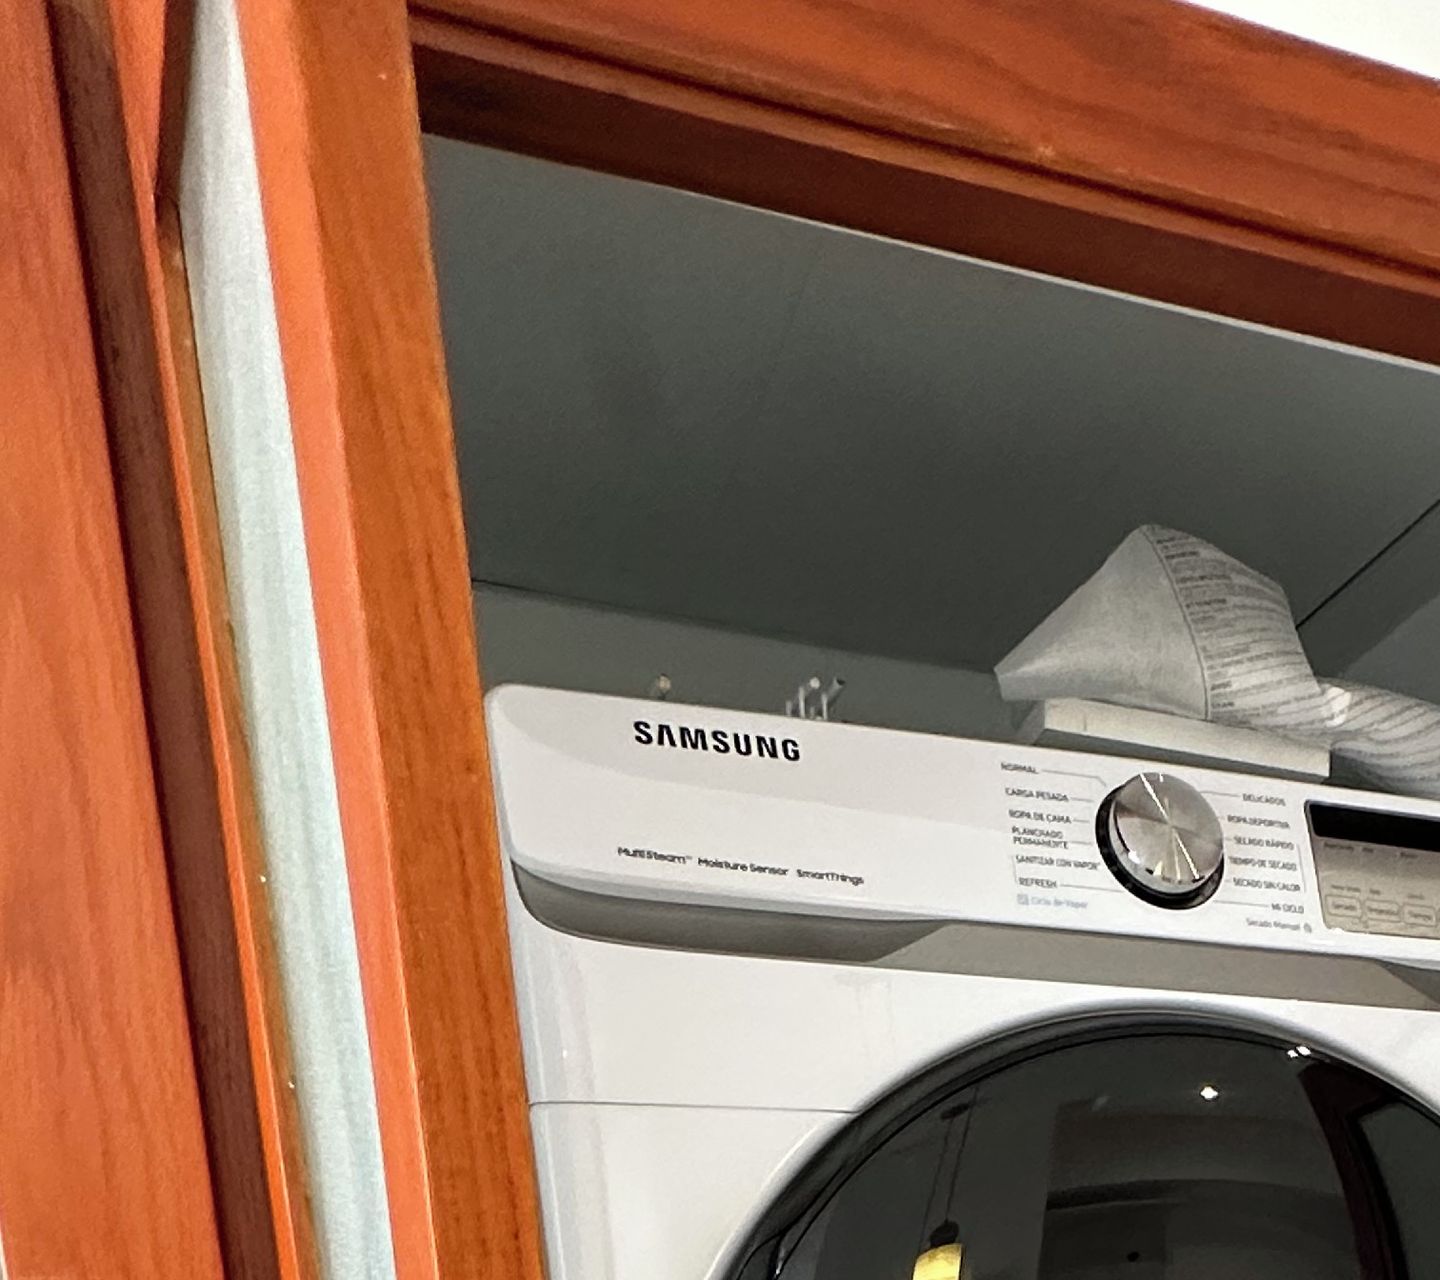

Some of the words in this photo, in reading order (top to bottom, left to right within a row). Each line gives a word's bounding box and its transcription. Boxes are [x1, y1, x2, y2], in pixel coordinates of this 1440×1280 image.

[633, 720, 800, 762] SAMSUNG
[697, 857, 748, 872] Moisture
[750, 863, 789, 876] Sensor
[796, 868, 864, 886] SmartThings
